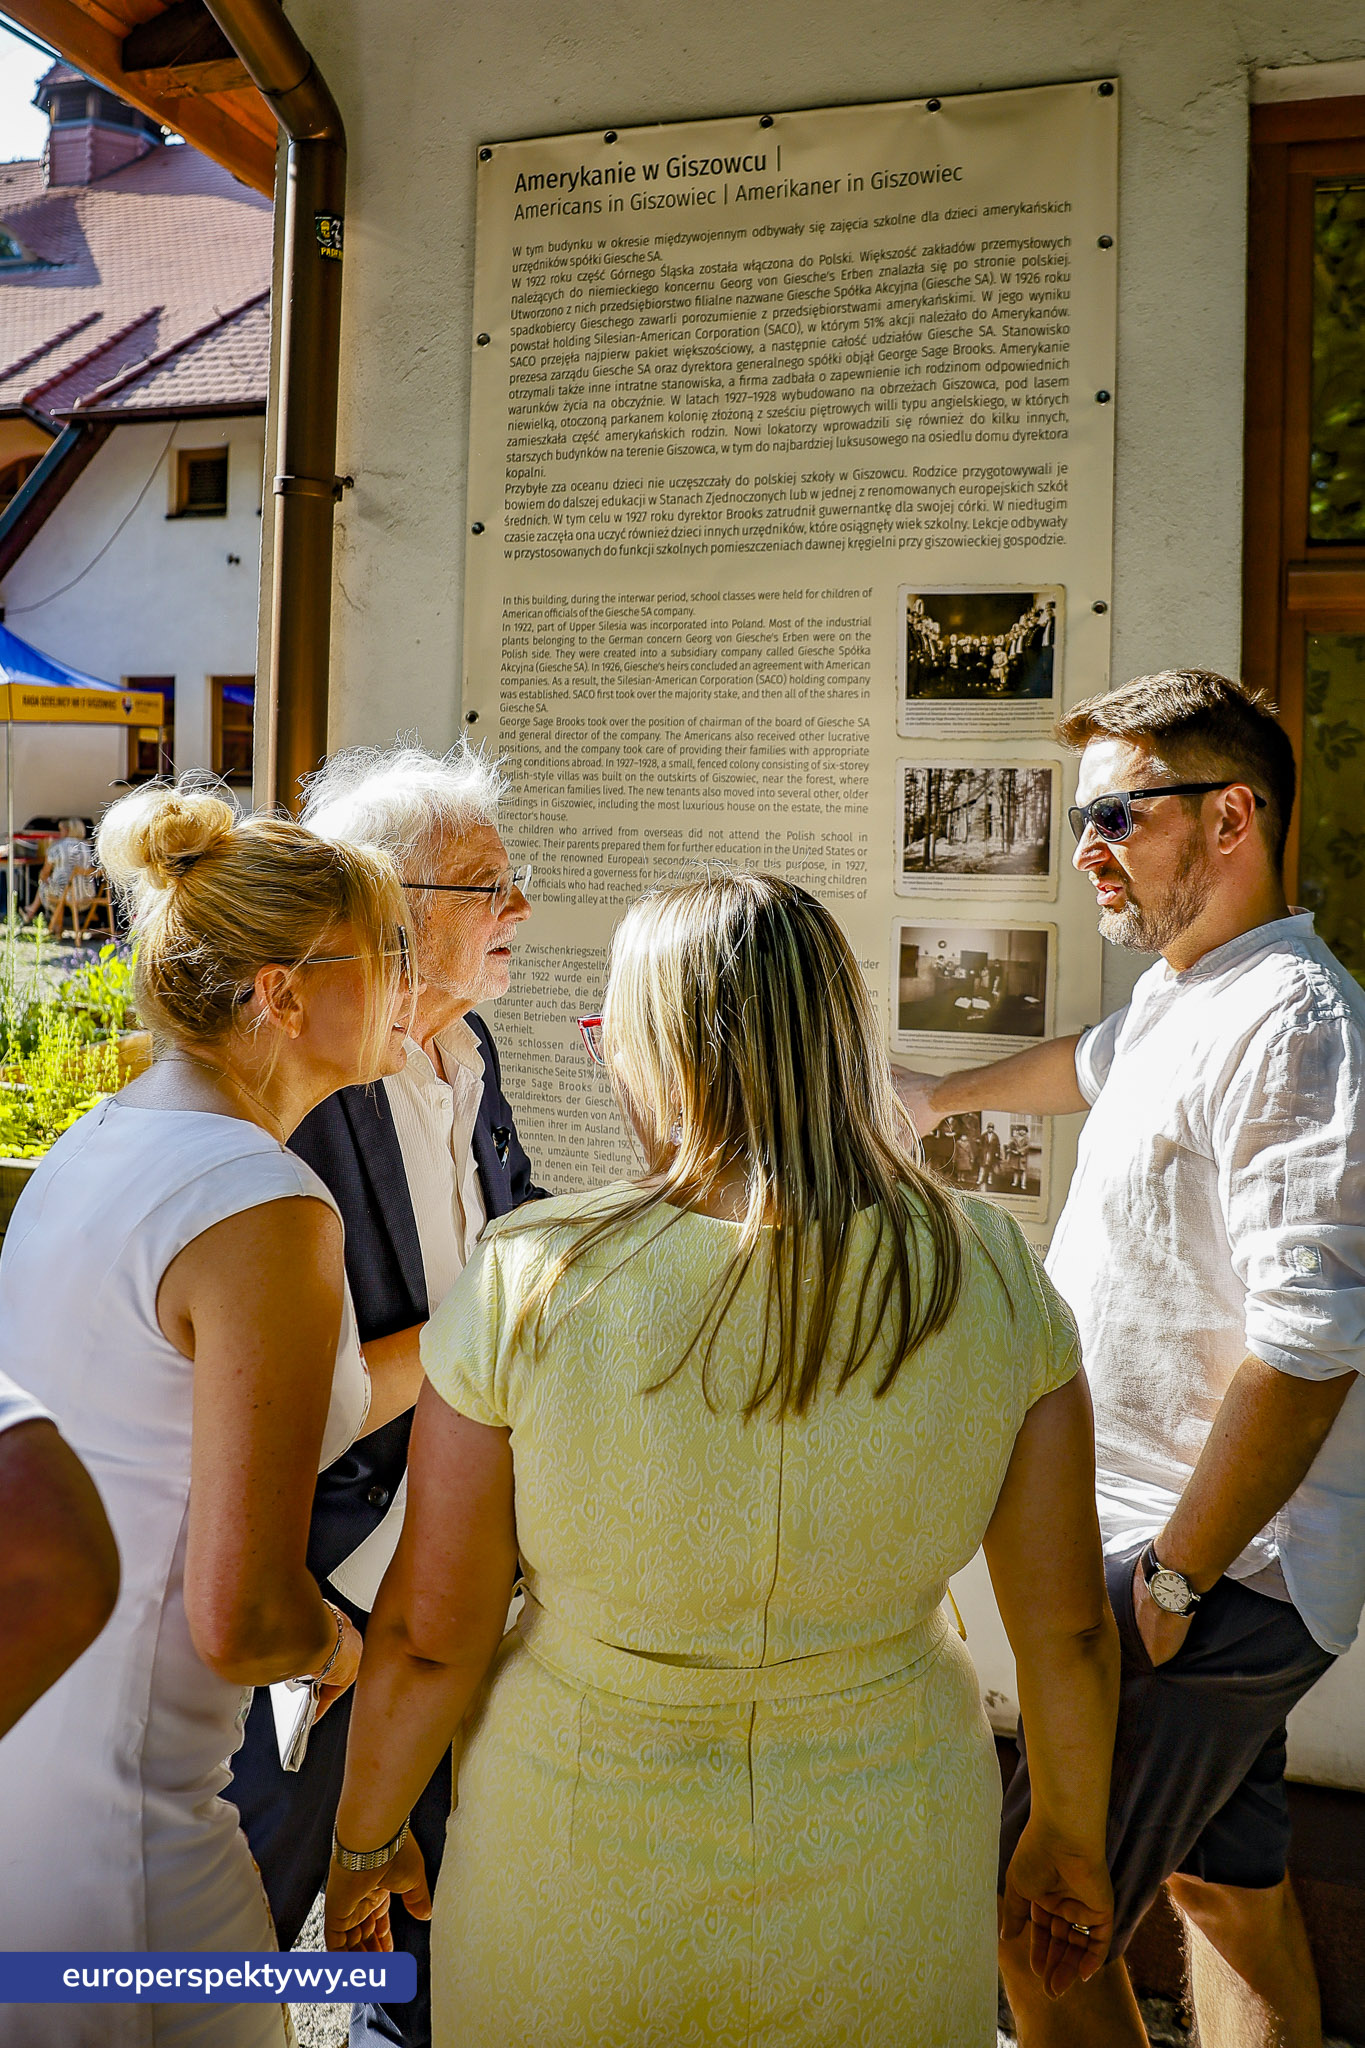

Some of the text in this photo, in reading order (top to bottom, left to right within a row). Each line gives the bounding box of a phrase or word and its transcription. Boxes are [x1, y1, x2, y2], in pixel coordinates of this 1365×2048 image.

[514, 160, 636, 194] Amerykanie
[643, 164, 659, 181] w
[666, 154, 767, 179] Giszowcu
[513, 197, 602, 221] Americans
[608, 194, 624, 213] in
[630, 188, 716, 211] Giszowiec
[735, 176, 841, 202] Amerikaner
[847, 173, 864, 192] in
[870, 164, 963, 190] Giszowiec
[511, 200, 1072, 259] W tym budynku w okresie międzywojennym odbywały się zajęcia szkolne dla dzieci amerykańskich
[511, 248, 663, 276] urzędników spółki Giesche SA.
[509, 287, 1071, 339] spadkobiercy Gieschego zawarli porozumienie z przedsiębiorstwami amerykańskimi. W jego wyniku
[509, 303, 1070, 356] powstał holding Silesian-American Corporation (SACO), w którym 51% akcji należało do Amerykanów.
[505, 425, 1069, 466] starszych budynków na terenie Giszowca, w tym do najbardziej luksusowego na osiedlu domu dyrektora
[505, 464, 546, 482] kopalni.
[503, 531, 1066, 561] w przystosowanych do funkcji szkolnych pomieszczeniach dawnej kręgielni przy giszowieckiej gospodzie.
[502, 586, 873, 608] In this building, during the interwar period, school classes were held for children of
[501, 605, 695, 619] American officials of the Giesche SA company.
[499, 715, 870, 730] George Sage Brooks took over the position of chairman of the board of Giesche SA
[496, 822, 868, 842] The children who arrived from overseas did not attend the Polish school in
[525, 944, 606, 958] Zwischenkriegszeit
[532, 972, 549, 981] 1922
[554, 973, 582, 983] wurde
[536, 1000, 576, 1009] auch das
[494, 1010, 566, 1023] diesen Betrieben
[494, 1023, 534, 1034] SA erhielt.
[518, 1039, 563, 1049] schlossen
[555, 1054, 585, 1064] Daraus
[532, 1079, 592, 1092] Sage Brooks
[557, 1108, 607, 1120] wurden von
[548, 1119, 620, 1135] ihrer im Ausland
[519, 1131, 614, 1148] konnten. In den Jahren
[547, 1147, 631, 1165] umzäunte Siedlung
